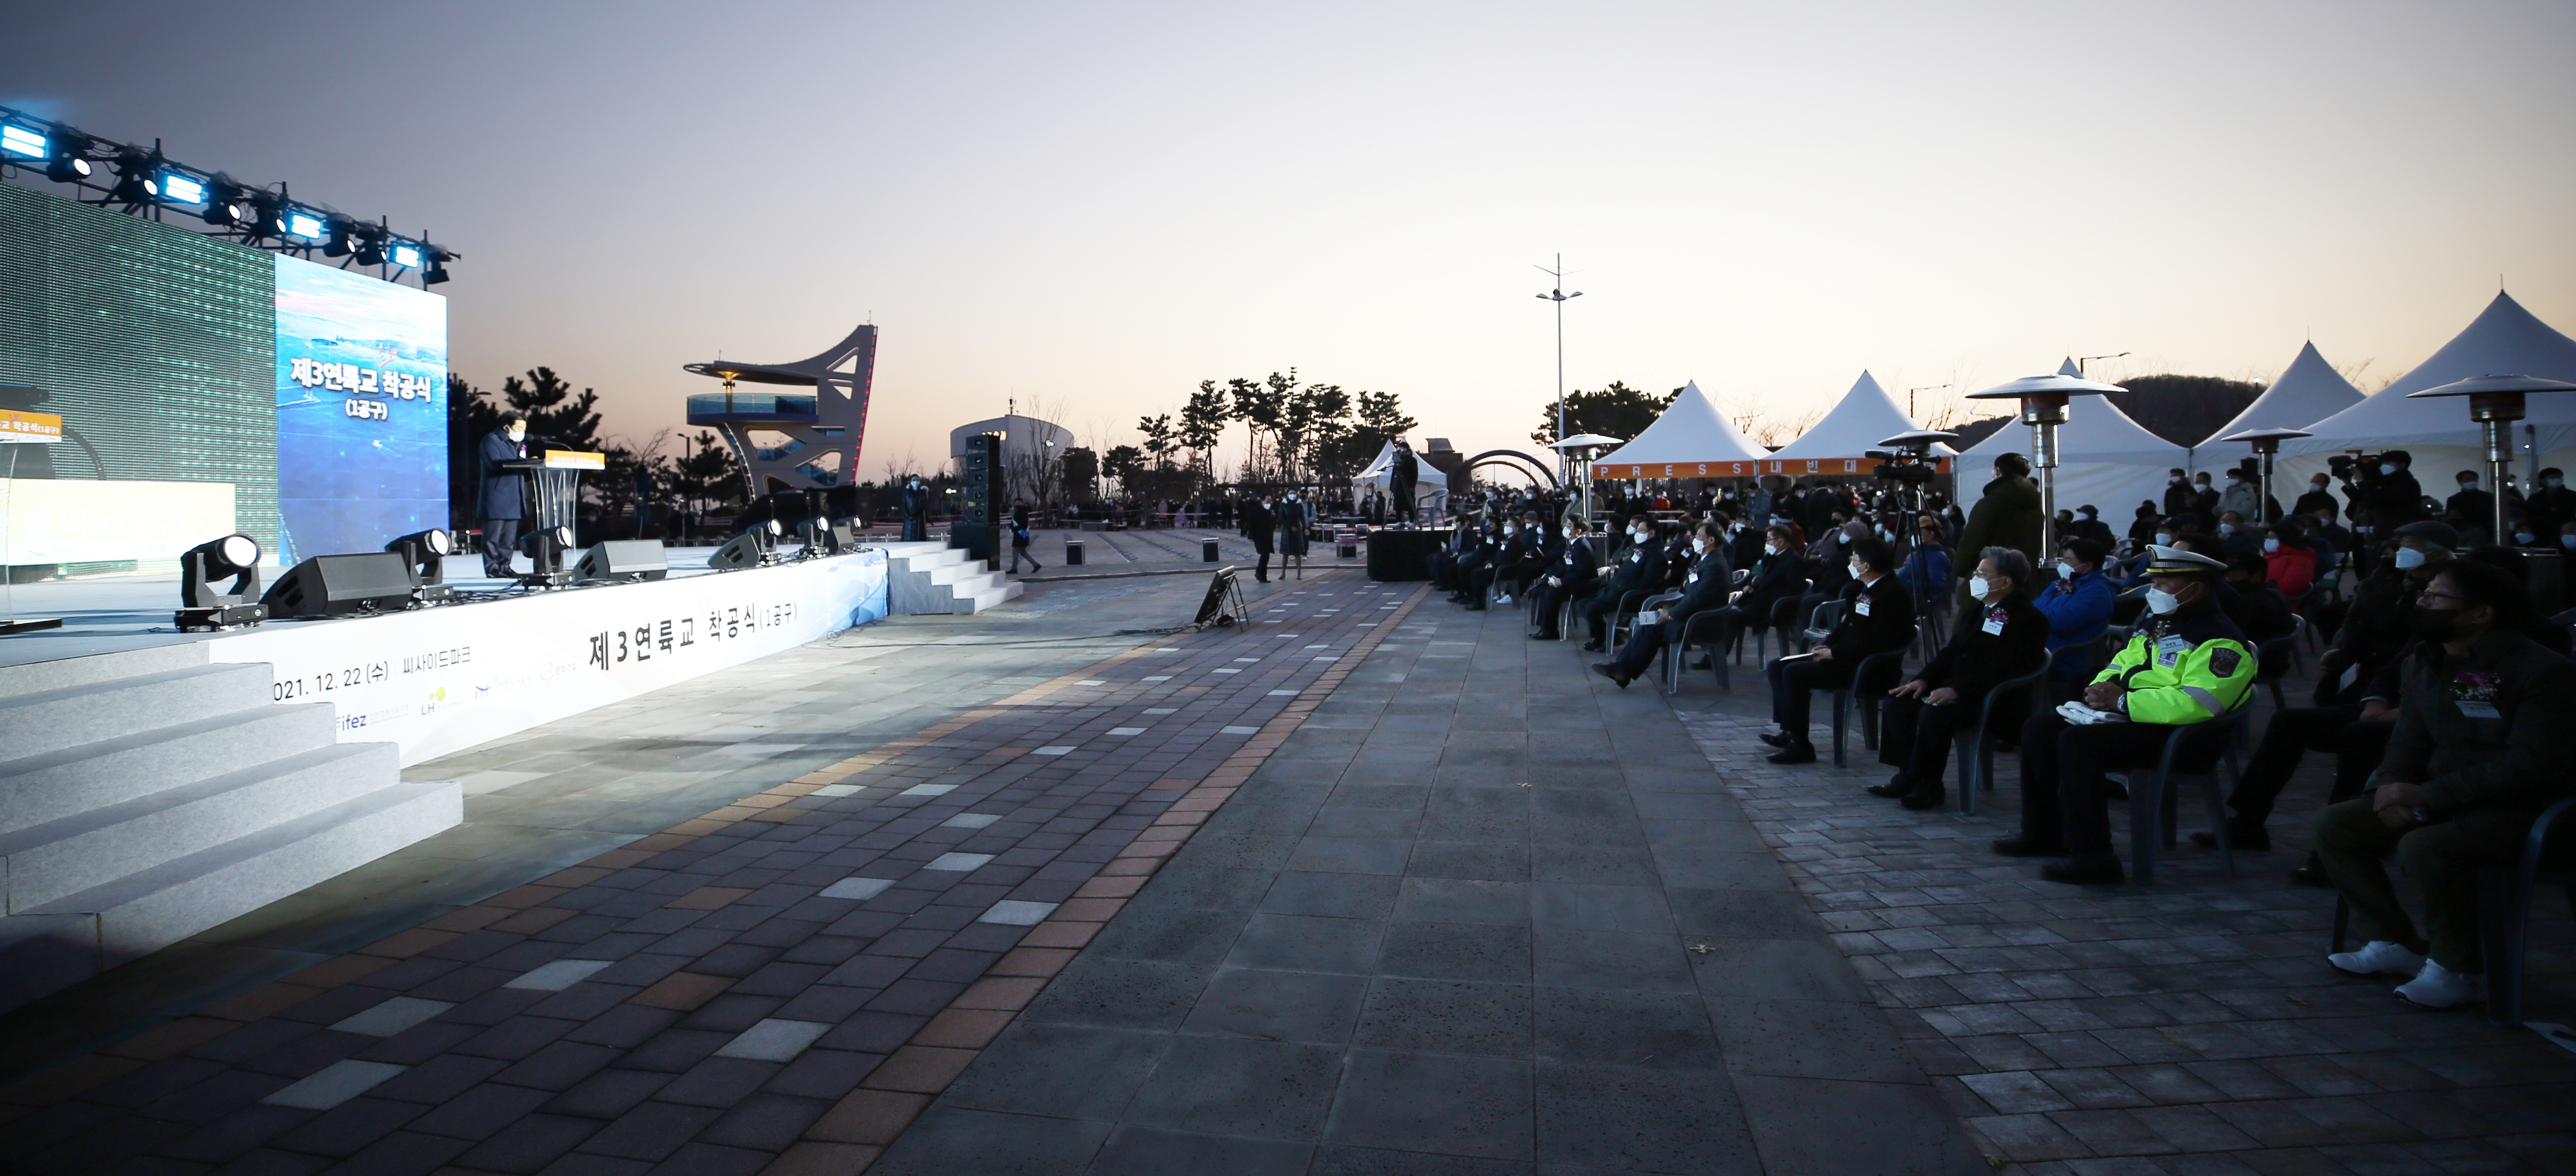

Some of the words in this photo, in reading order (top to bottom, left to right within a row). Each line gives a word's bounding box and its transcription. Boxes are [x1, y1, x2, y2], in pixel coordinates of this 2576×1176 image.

[290, 357, 379, 394] 제3연륙교
[382, 370, 431, 403] 착공식
[345, 398, 388, 421] (1공구)
[1601, 463, 1742, 477] PRESS
[274, 679, 309, 701] 021.
[316, 673, 338, 692] 12.
[402, 646, 471, 674] 씨사이드파크
[421, 703, 435, 716] LH
